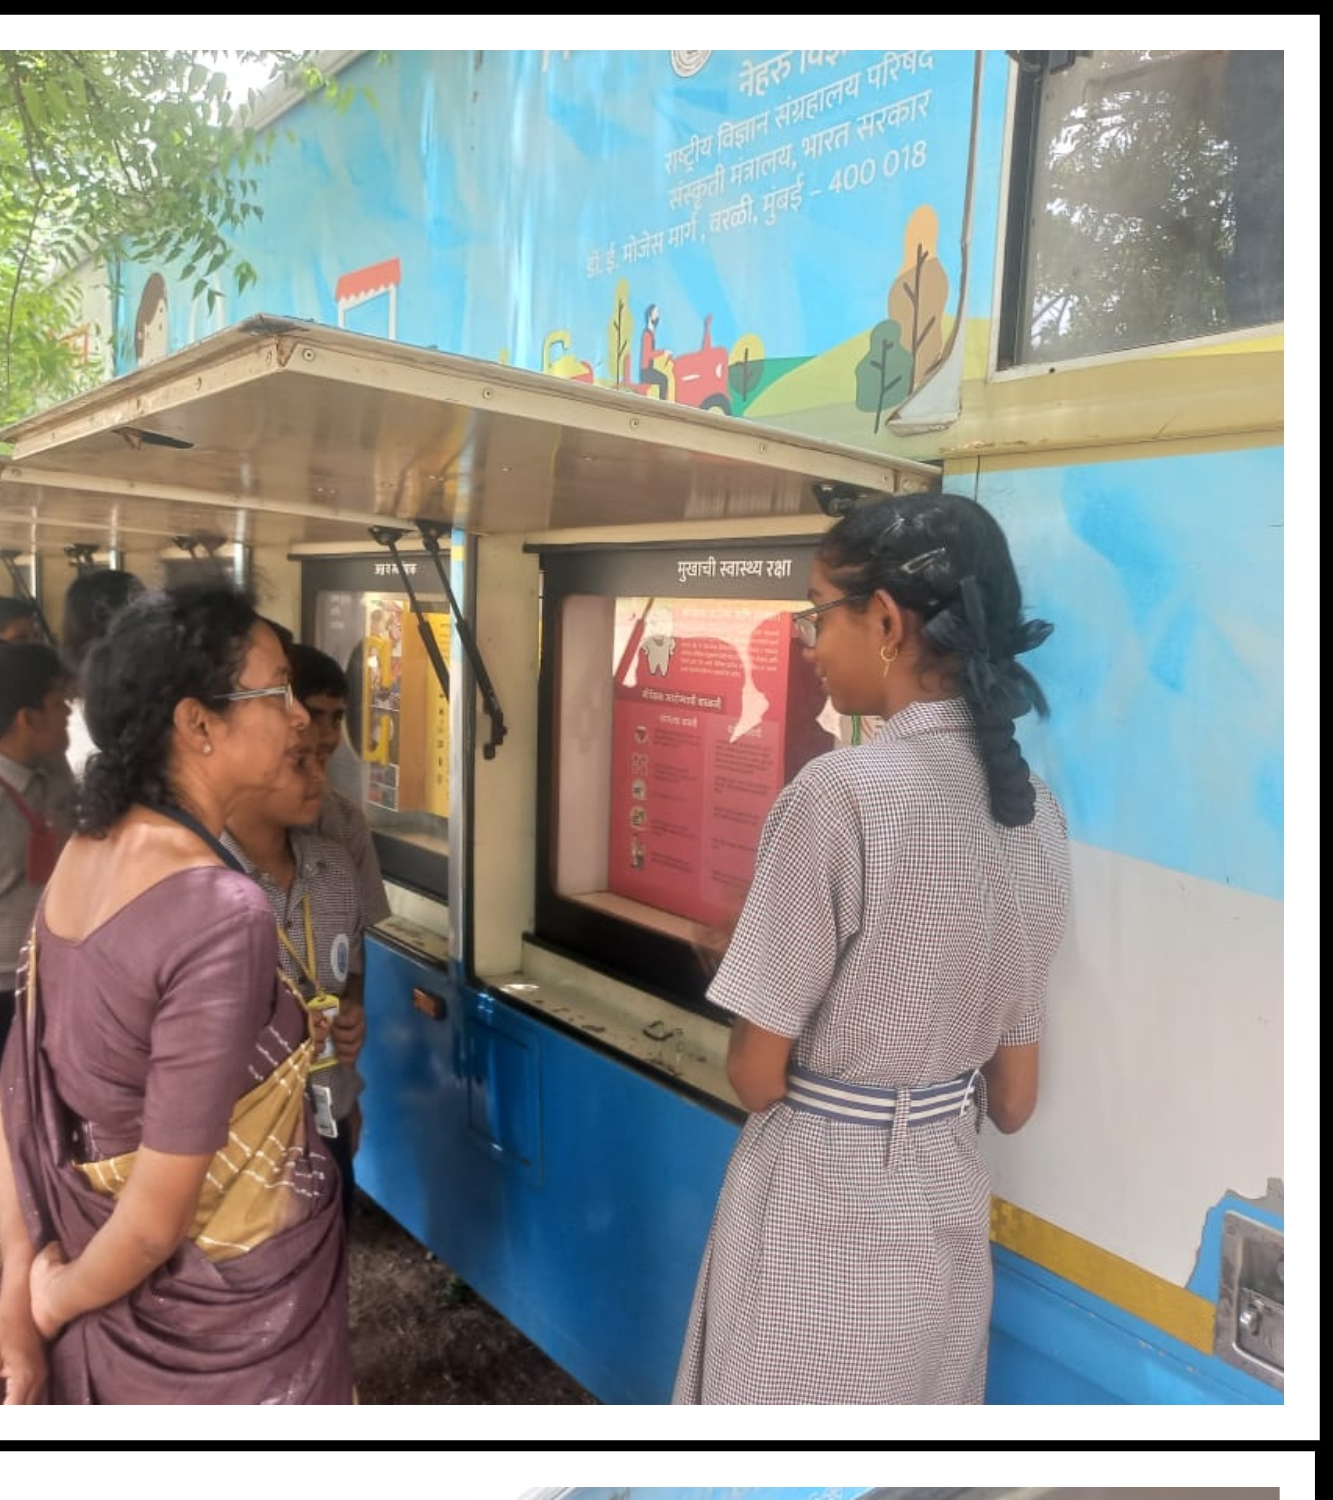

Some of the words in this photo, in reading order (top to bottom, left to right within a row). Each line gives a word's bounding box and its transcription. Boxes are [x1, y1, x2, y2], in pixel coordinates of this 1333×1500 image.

[664, 134, 713, 174] राष्ट्रीय
[717, 121, 770, 151] विज्ञान
[775, 72, 861, 128] संग्रहालय
[802, 121, 852, 158] भारत
[856, 89, 933, 140] सरकार
[763, 172, 805, 226] मुंबई
[827, 157, 876, 193] 400
[882, 139, 928, 177] 018
[677, 556, 717, 582] मुखाची
[719, 560, 764, 578] स्वास्थ्य
[766, 559, 792, 579] रक्षा
